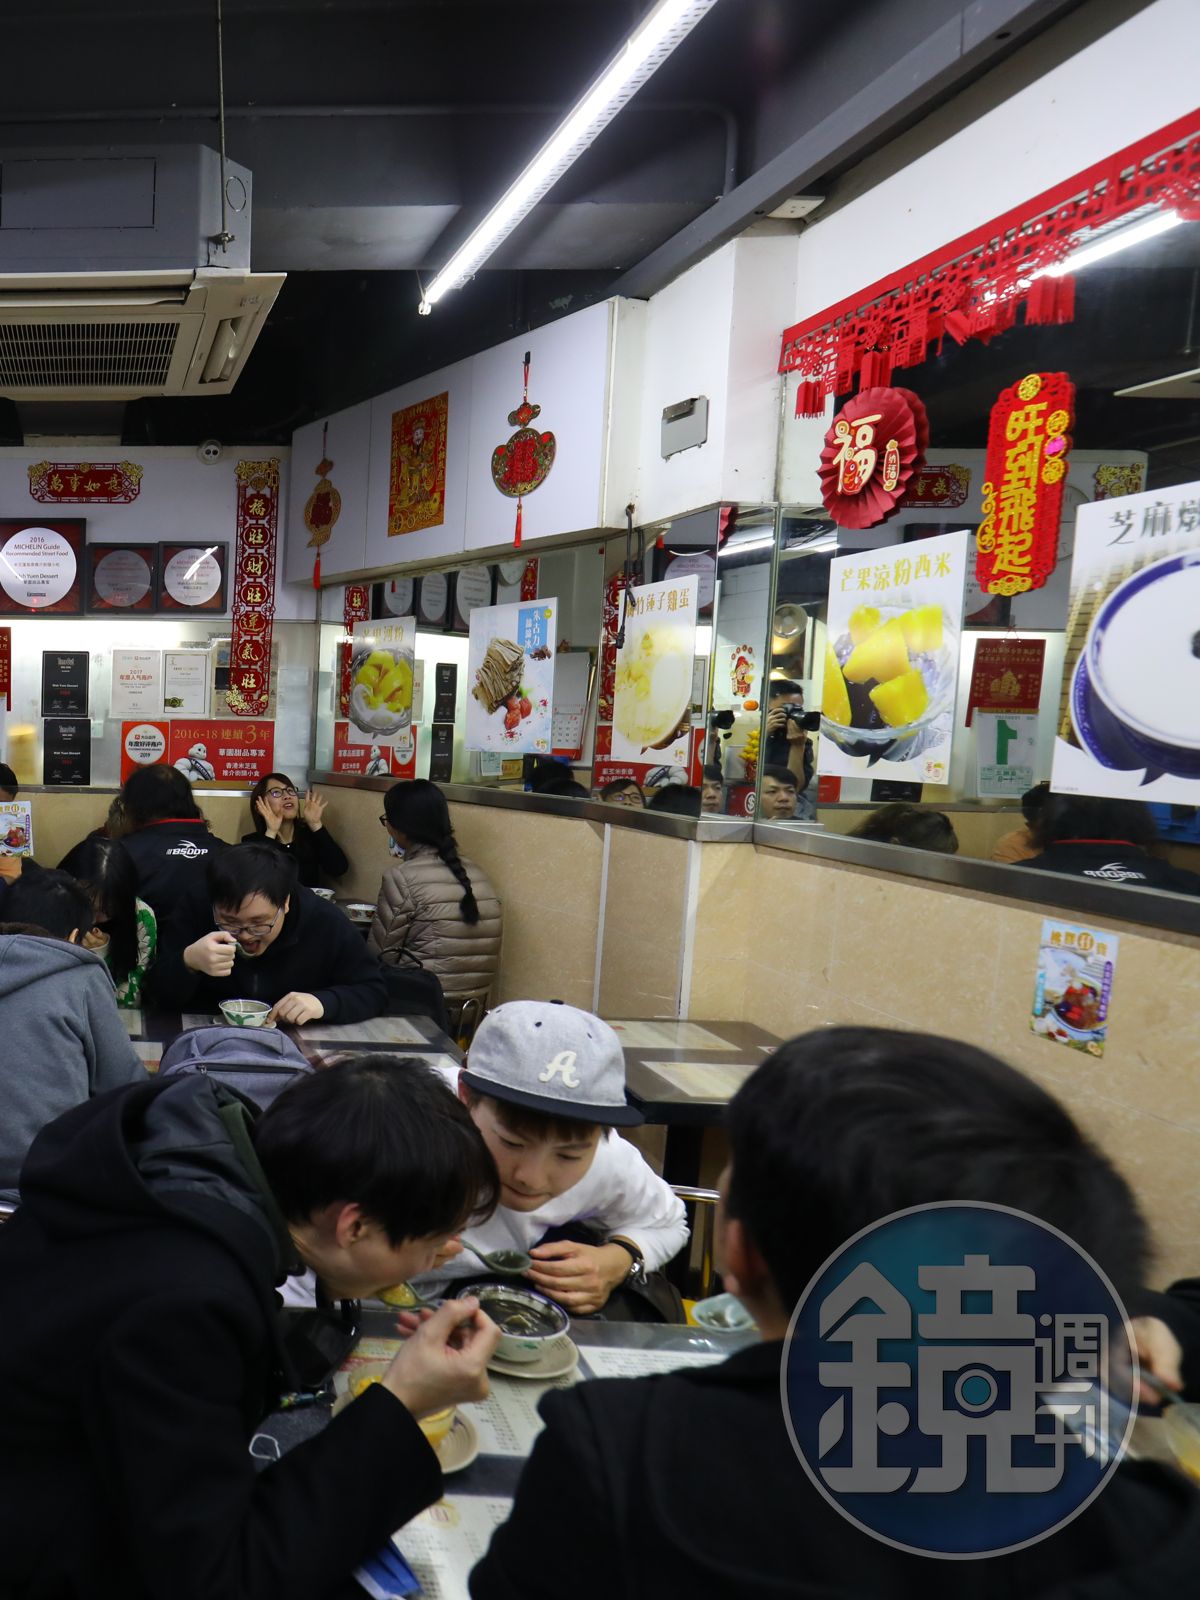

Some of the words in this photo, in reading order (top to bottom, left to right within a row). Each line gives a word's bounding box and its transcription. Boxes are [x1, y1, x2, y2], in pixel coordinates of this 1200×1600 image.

[832, 413, 883, 494] 福
[50, 473, 122, 492] 萬事如意
[991, 401, 1048, 576] 旺到飛起
[841, 552, 952, 592] 芒果涼粉西米
[174, 729, 218, 740] 2016-18
[537, 1050, 580, 1088] A
